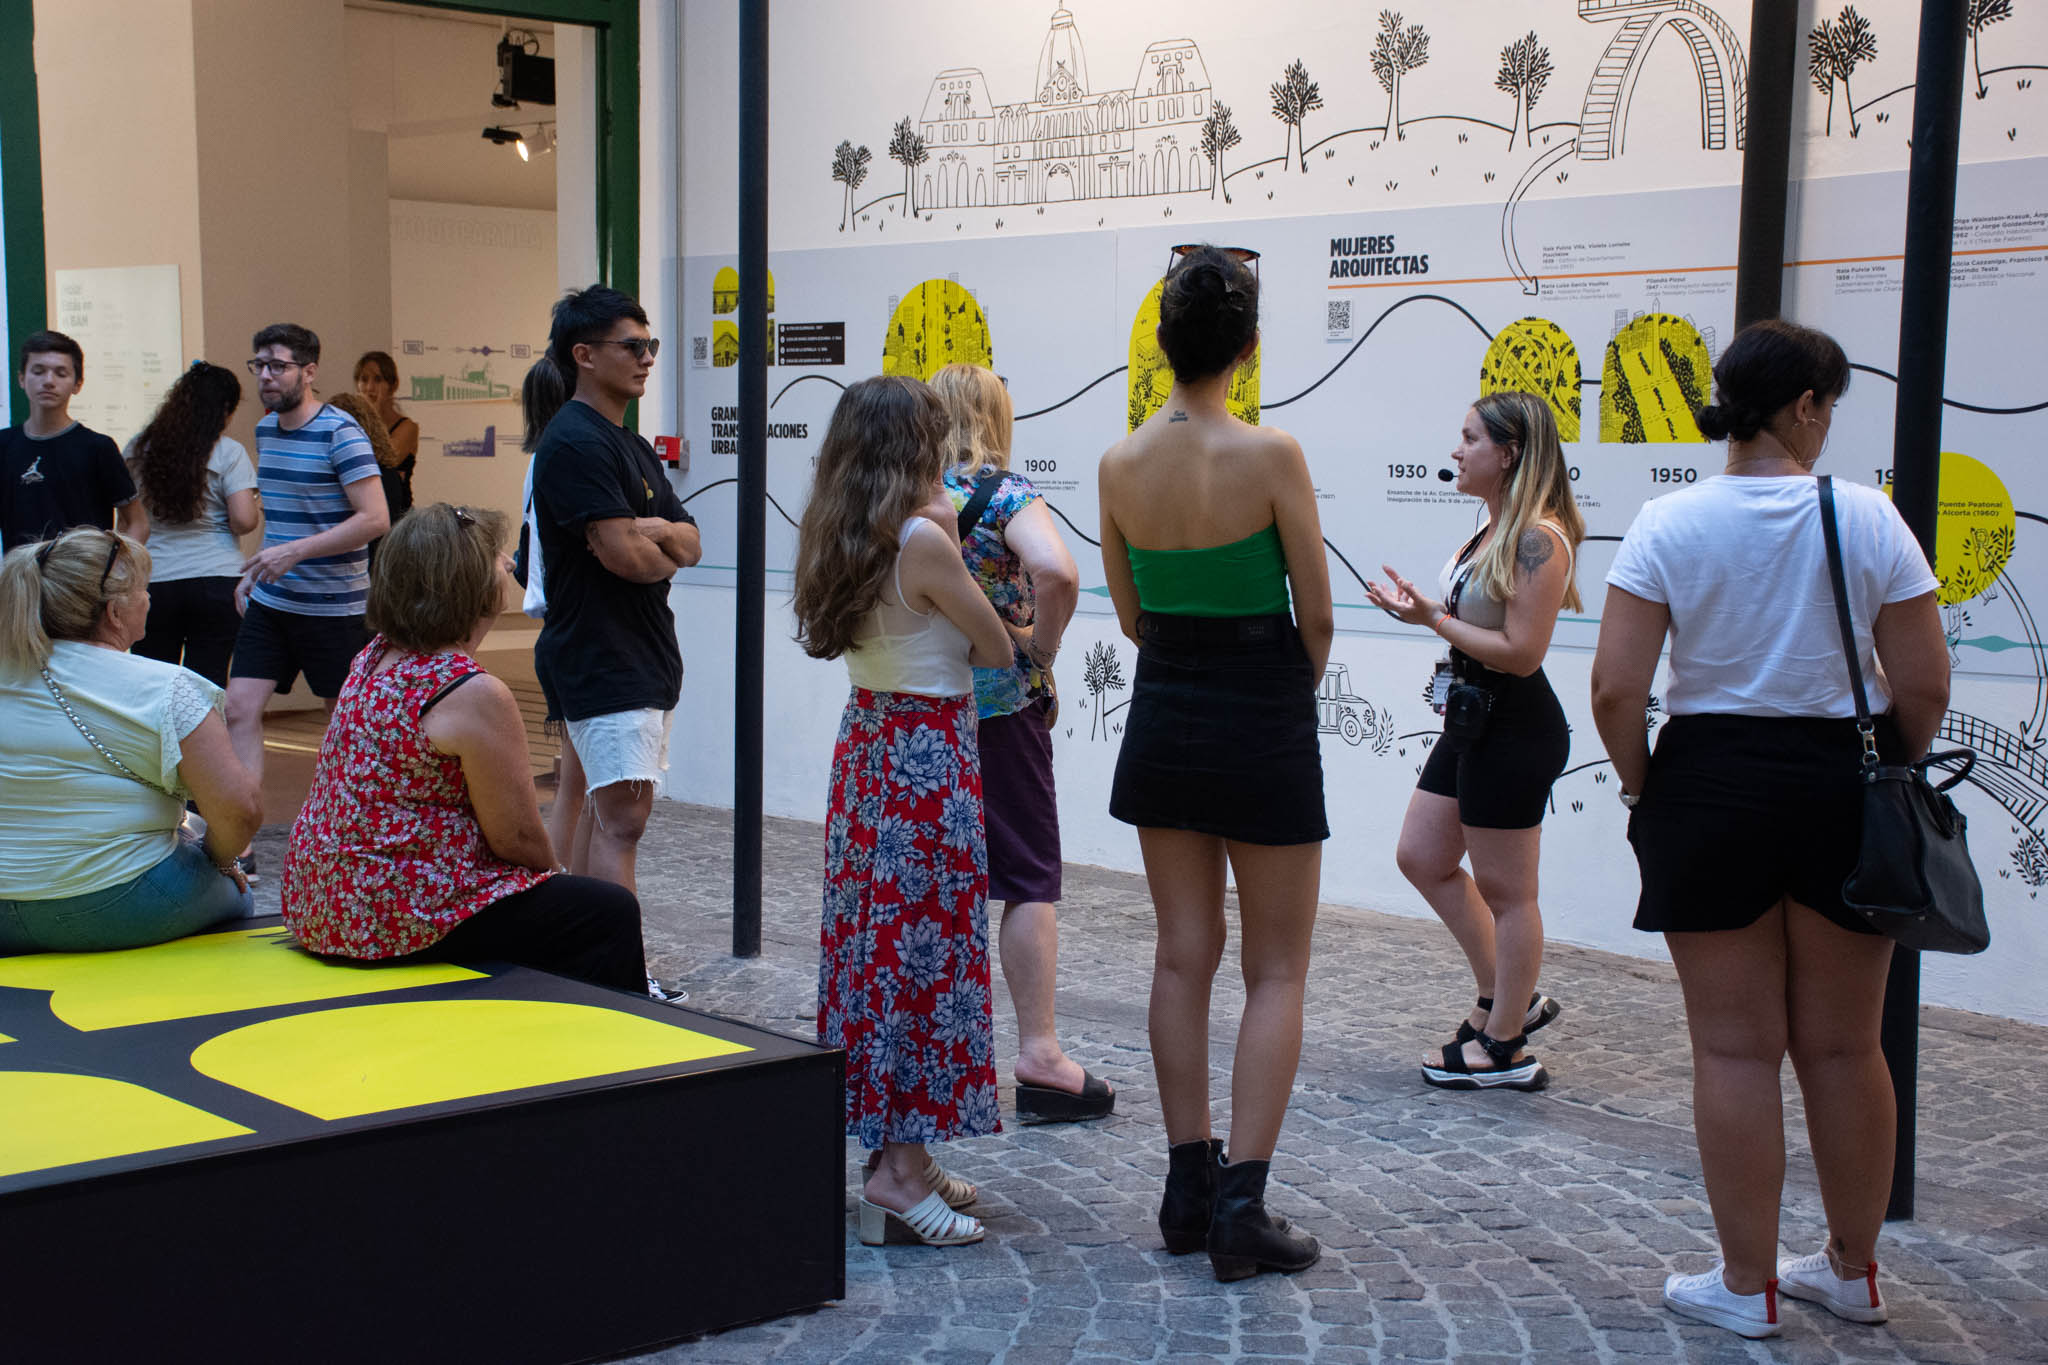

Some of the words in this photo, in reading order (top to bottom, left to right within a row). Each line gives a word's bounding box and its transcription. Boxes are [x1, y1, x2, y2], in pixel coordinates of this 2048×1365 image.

[1330, 235, 1395, 257] MUJERES
[1329, 254, 1429, 279] ARQUITECTAS
[711, 406, 738, 422] GRAN
[711, 440, 738, 455] URBA
[1024, 459, 1056, 472] 1900
[1388, 464, 1428, 478] 1930
[1650, 468, 1697, 483] 1950
